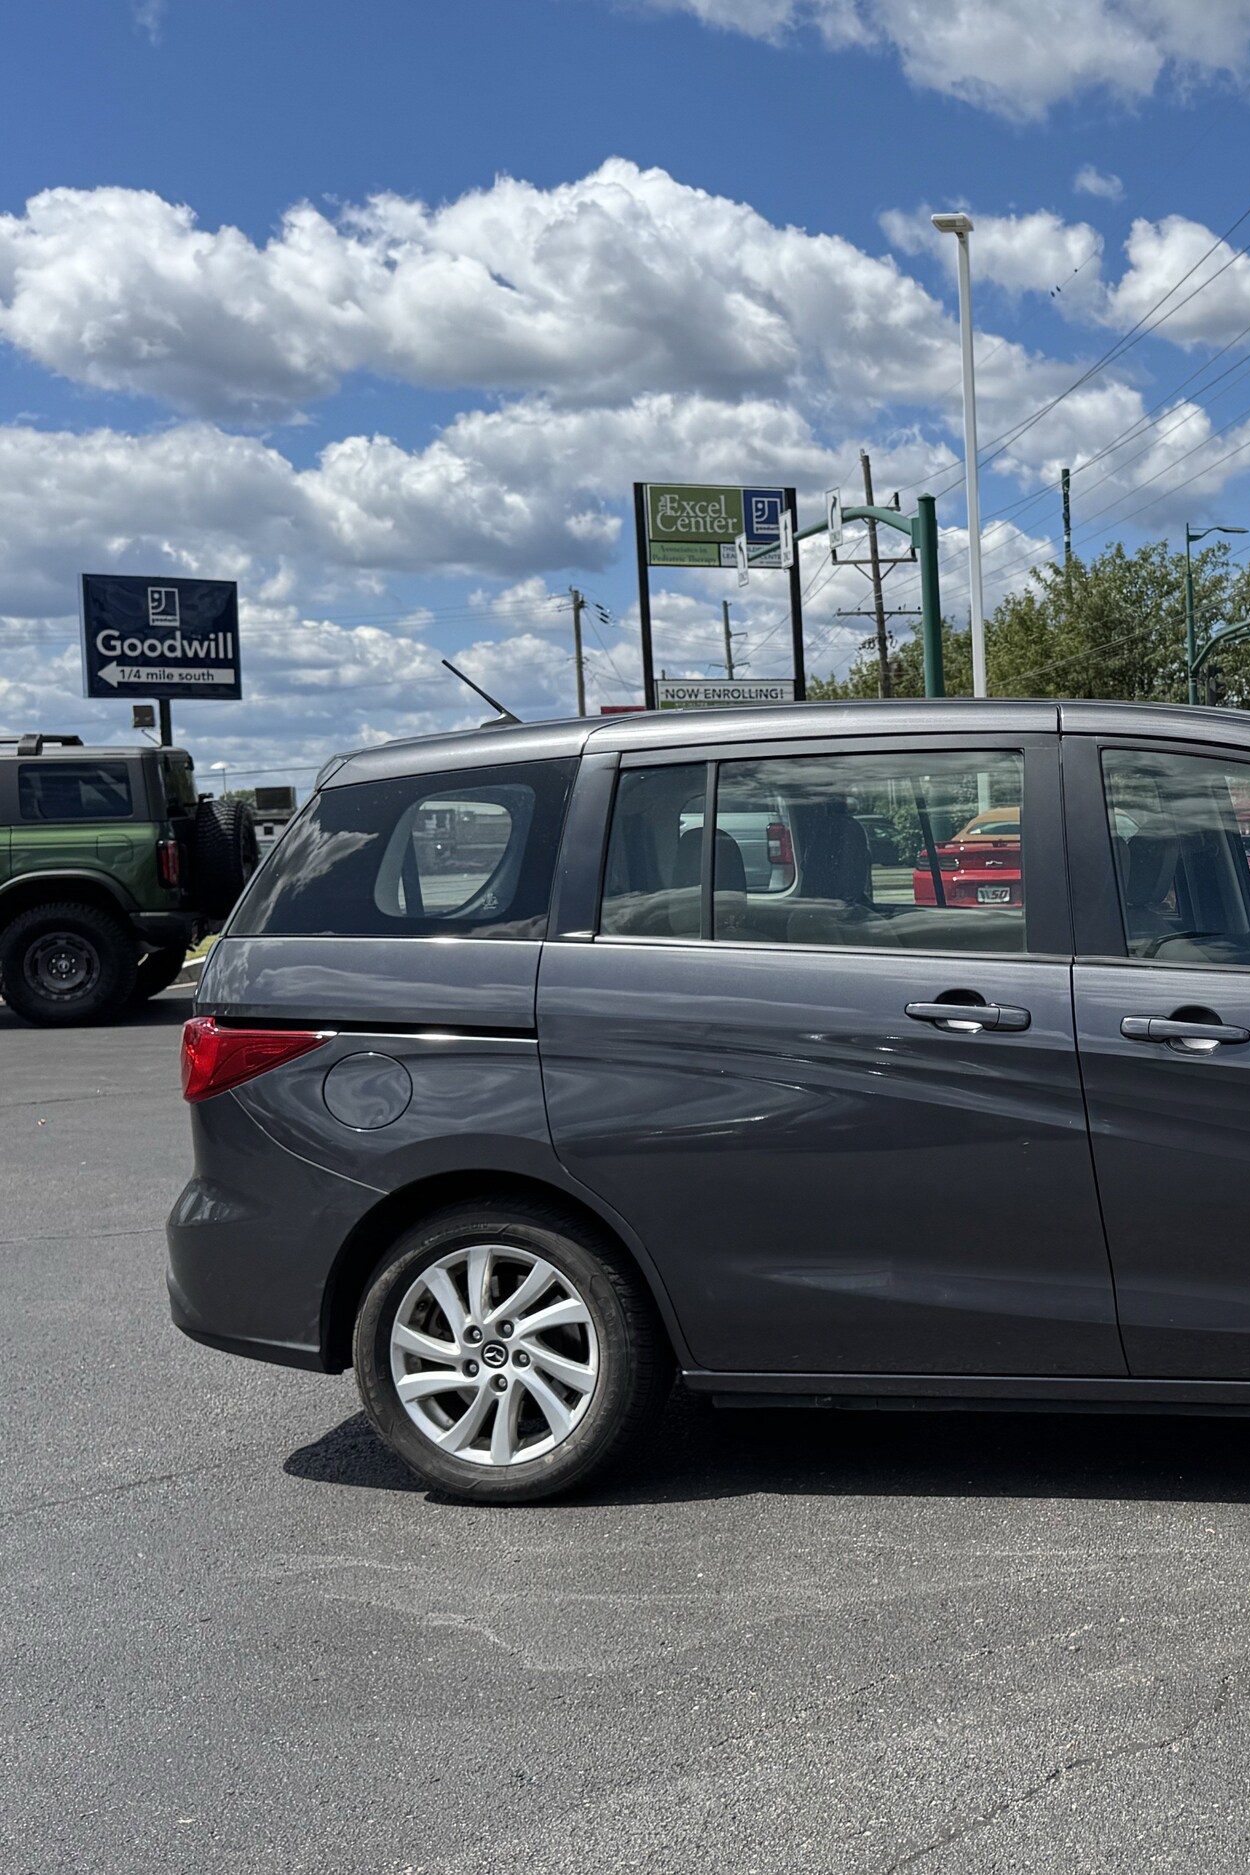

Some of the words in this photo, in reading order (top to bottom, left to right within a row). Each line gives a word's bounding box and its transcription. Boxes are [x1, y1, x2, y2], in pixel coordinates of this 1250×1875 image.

[664, 494, 728, 518] Excel
[656, 510, 738, 534] Center
[96, 629, 233, 660] Goodwill
[119, 669, 142, 680] 1/4
[146, 669, 174, 681] mile
[178, 670, 215, 682] south
[665, 688, 700, 700] NOW
[703, 688, 784, 700] ENROLLING!
